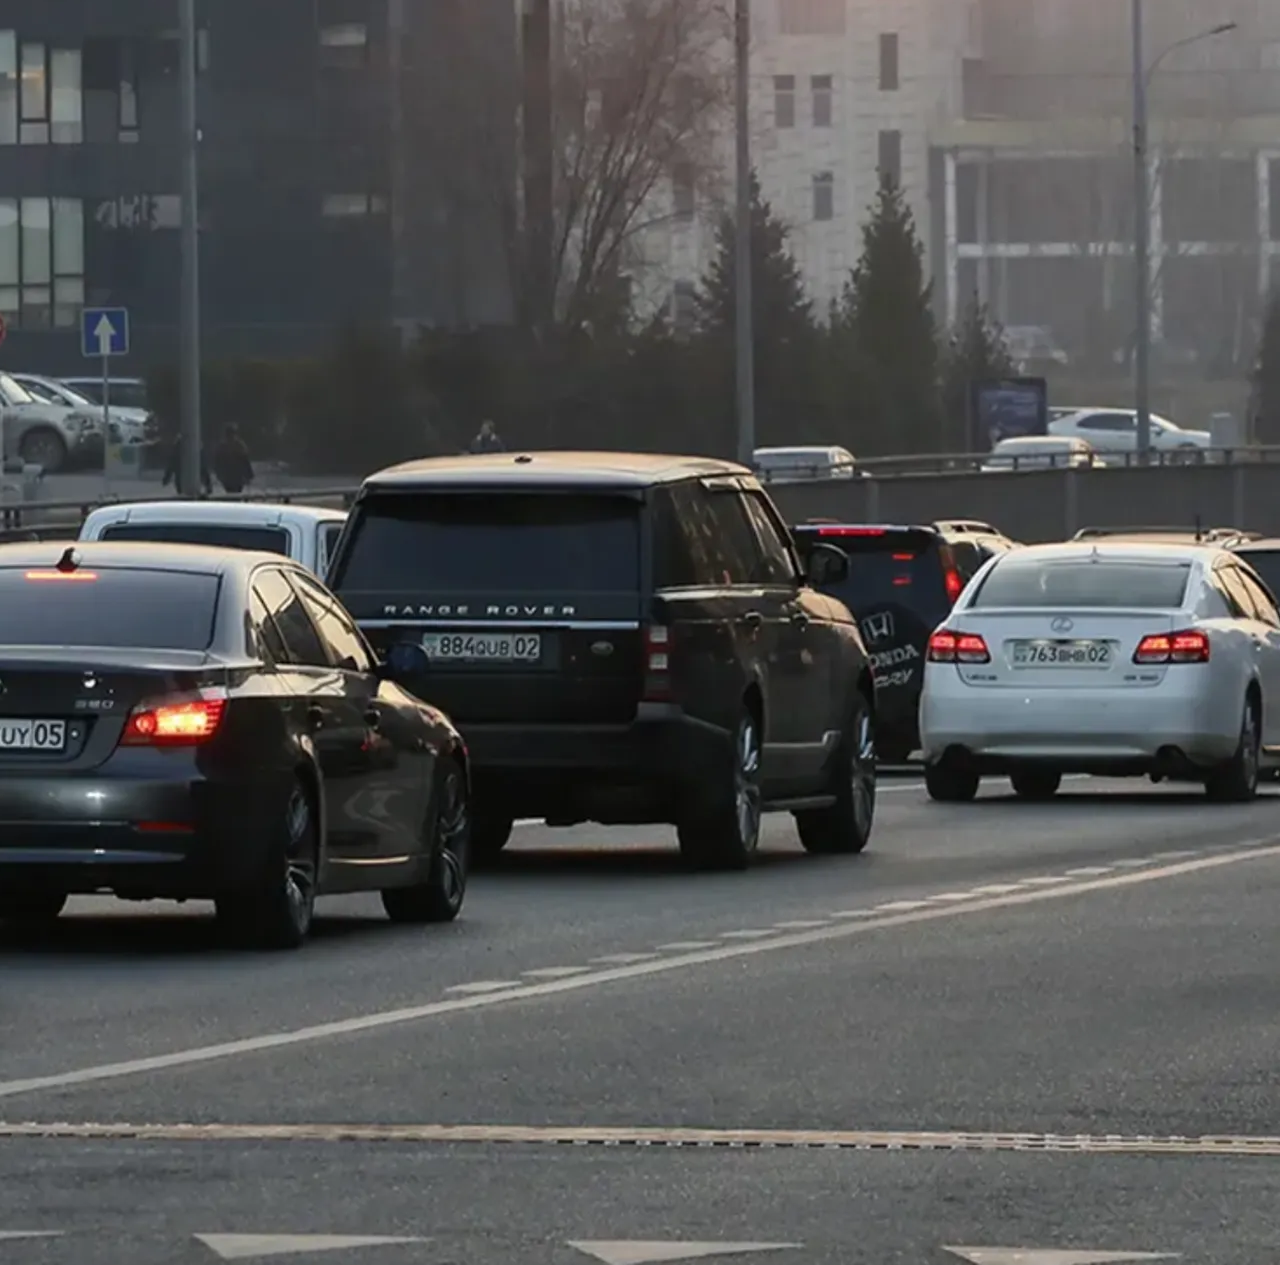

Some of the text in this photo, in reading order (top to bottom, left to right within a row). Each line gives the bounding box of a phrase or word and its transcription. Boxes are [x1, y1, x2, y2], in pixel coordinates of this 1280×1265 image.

[384, 605, 575, 615] RANGE ROVER
[34, 723, 62, 746] 05
